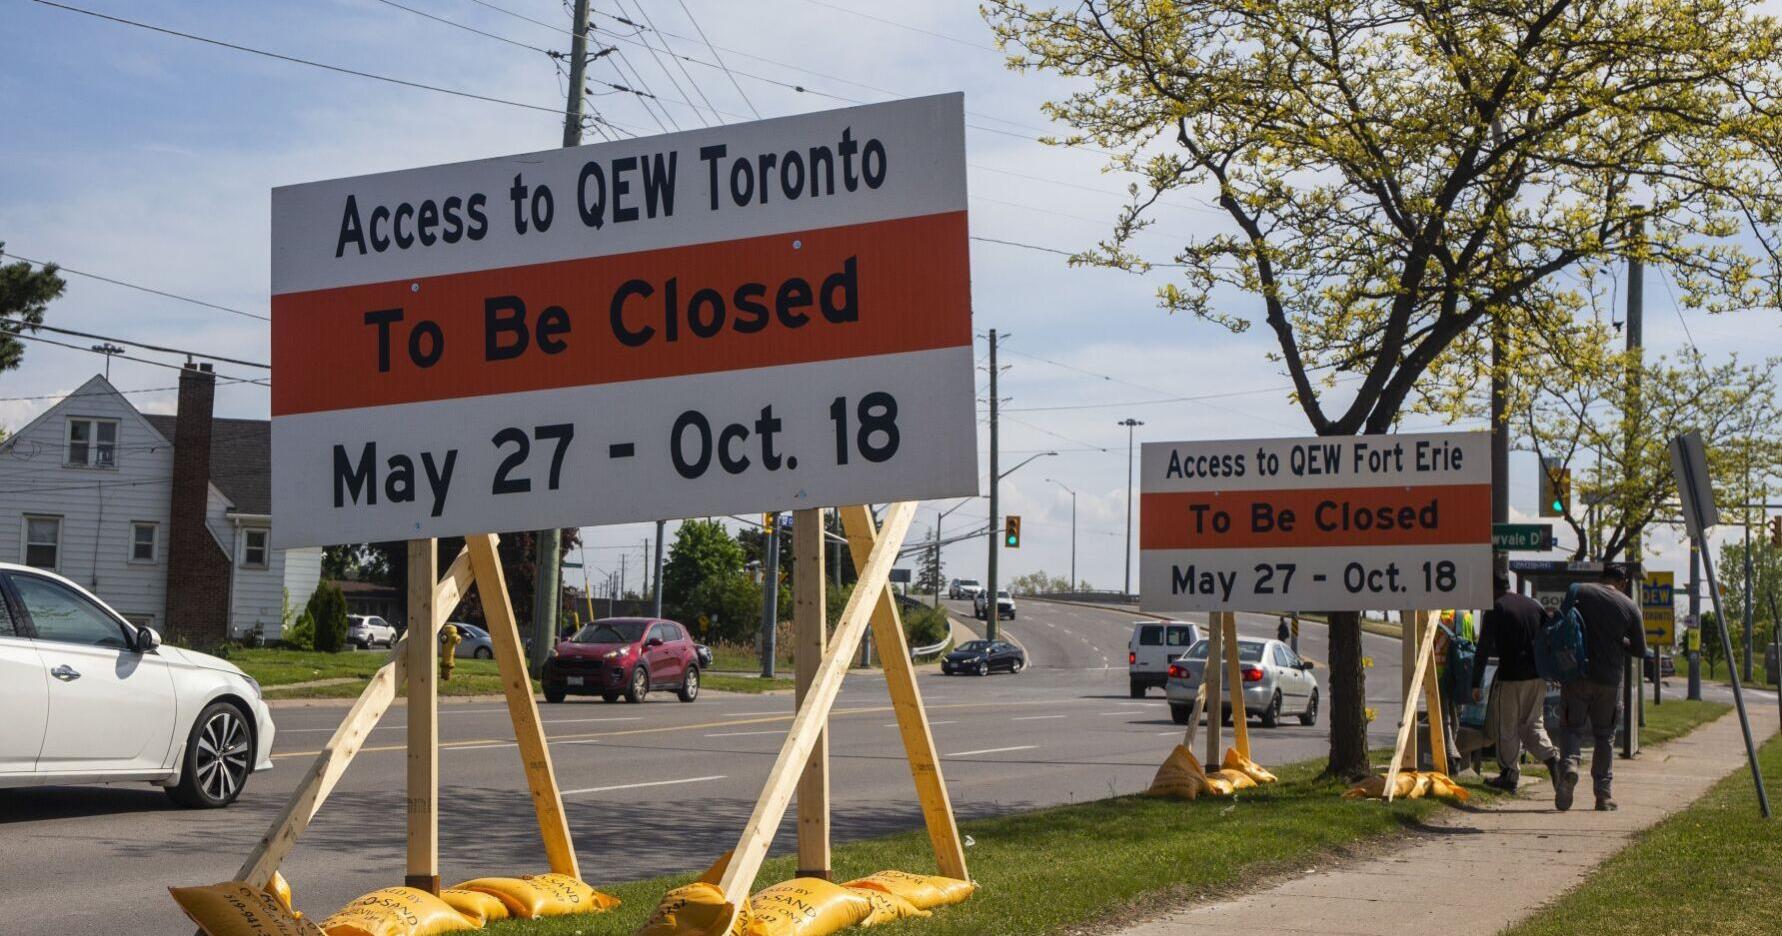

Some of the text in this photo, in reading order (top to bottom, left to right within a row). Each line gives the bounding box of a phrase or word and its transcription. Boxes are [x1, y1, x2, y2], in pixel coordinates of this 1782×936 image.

[335, 126, 888, 258] Access to QEW Toronto
[363, 254, 860, 374] To Be Closed
[333, 391, 902, 518] May 27 - Oct. 18
[1166, 440, 1463, 479] Access to QEW Fort Erie
[1188, 497, 1440, 536] To Be Closed
[1171, 559, 1457, 603] May 27 - Oct. 18
